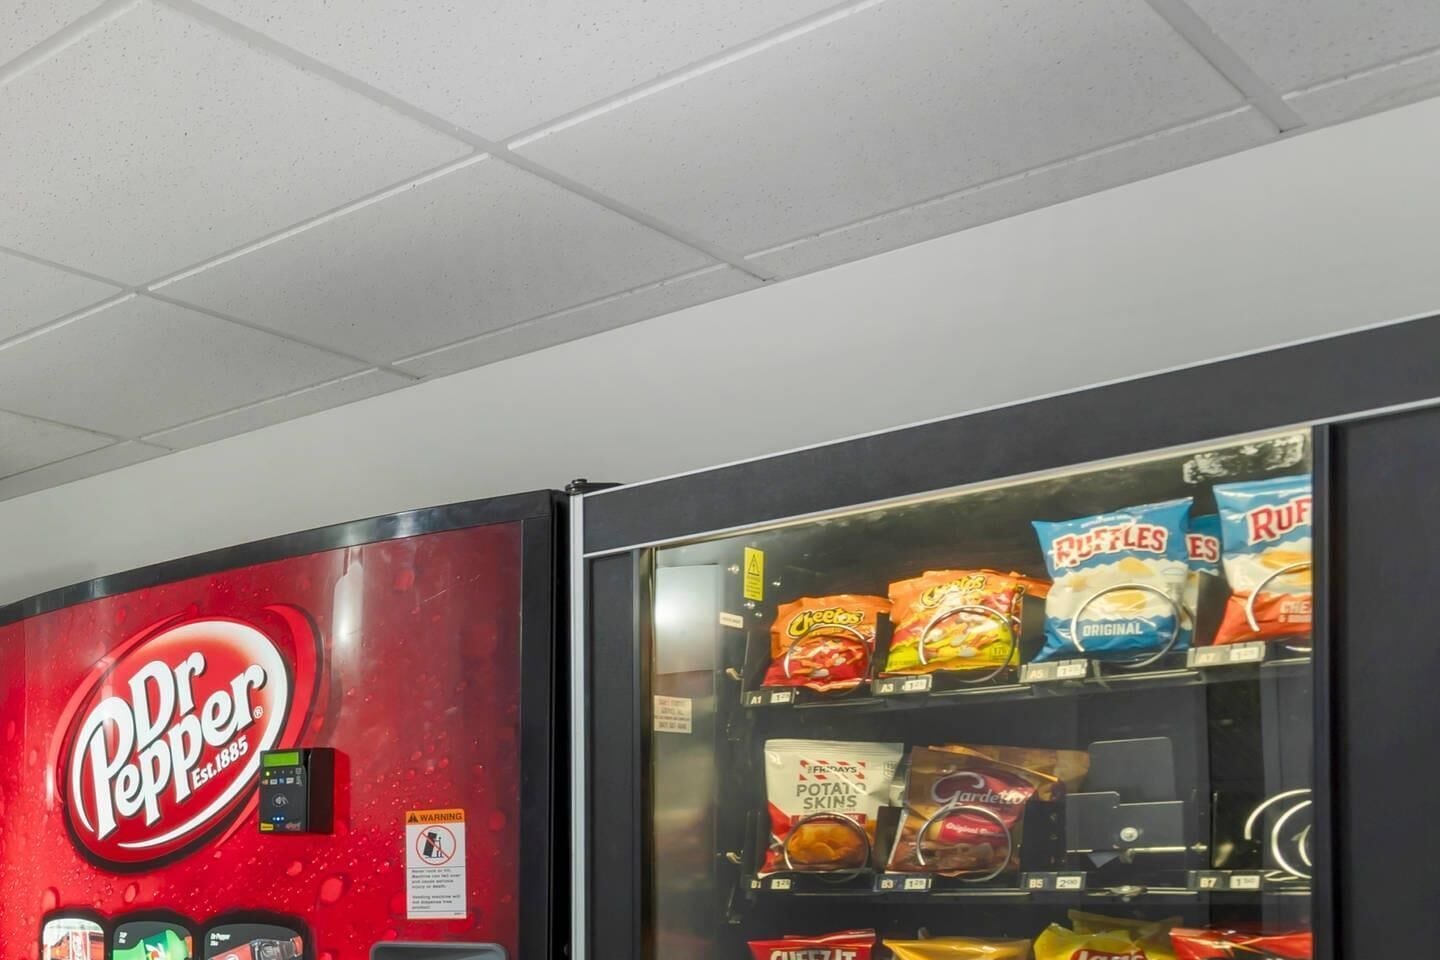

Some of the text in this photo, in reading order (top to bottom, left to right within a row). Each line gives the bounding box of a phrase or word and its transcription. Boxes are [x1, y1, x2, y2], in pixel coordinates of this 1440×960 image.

[1053, 525, 1168, 567] RUFFLES
[788, 607, 863, 637] Cheetos
[1083, 623, 1144, 637] ORIGINAL
[128, 652, 206, 753] Dr
[72, 664, 264, 841] Pepper
[420, 812, 463, 822] WARNING
[803, 795, 857, 810] SKINS
